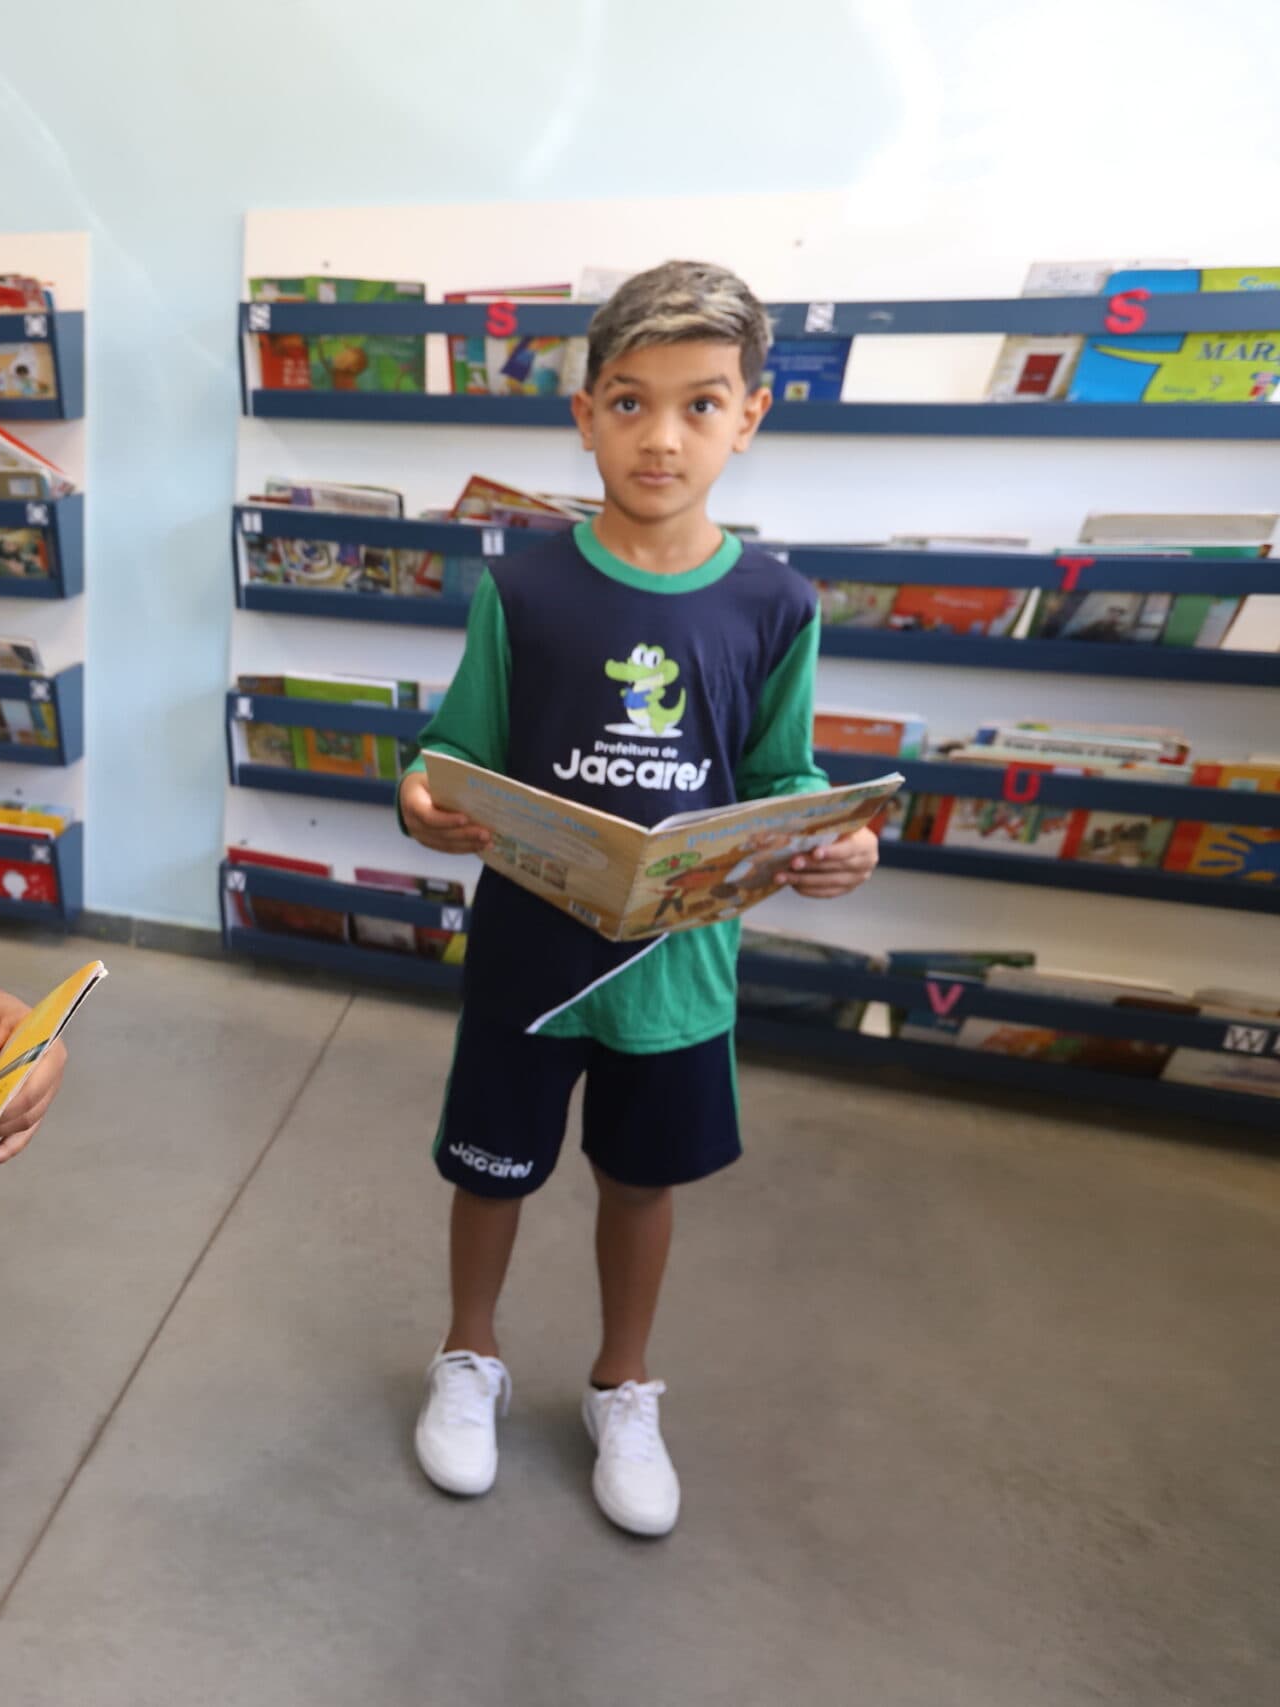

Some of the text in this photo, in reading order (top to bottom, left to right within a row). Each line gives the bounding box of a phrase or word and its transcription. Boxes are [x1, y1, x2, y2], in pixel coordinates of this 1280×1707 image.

[486, 301, 518, 337] S
[1105, 288, 1151, 334] S
[1197, 341, 1280, 362] MAR
[1055, 557, 1095, 591] T
[594, 740, 678, 759] Prefeitura de
[1003, 762, 1041, 802] U
[927, 982, 964, 1015] V
